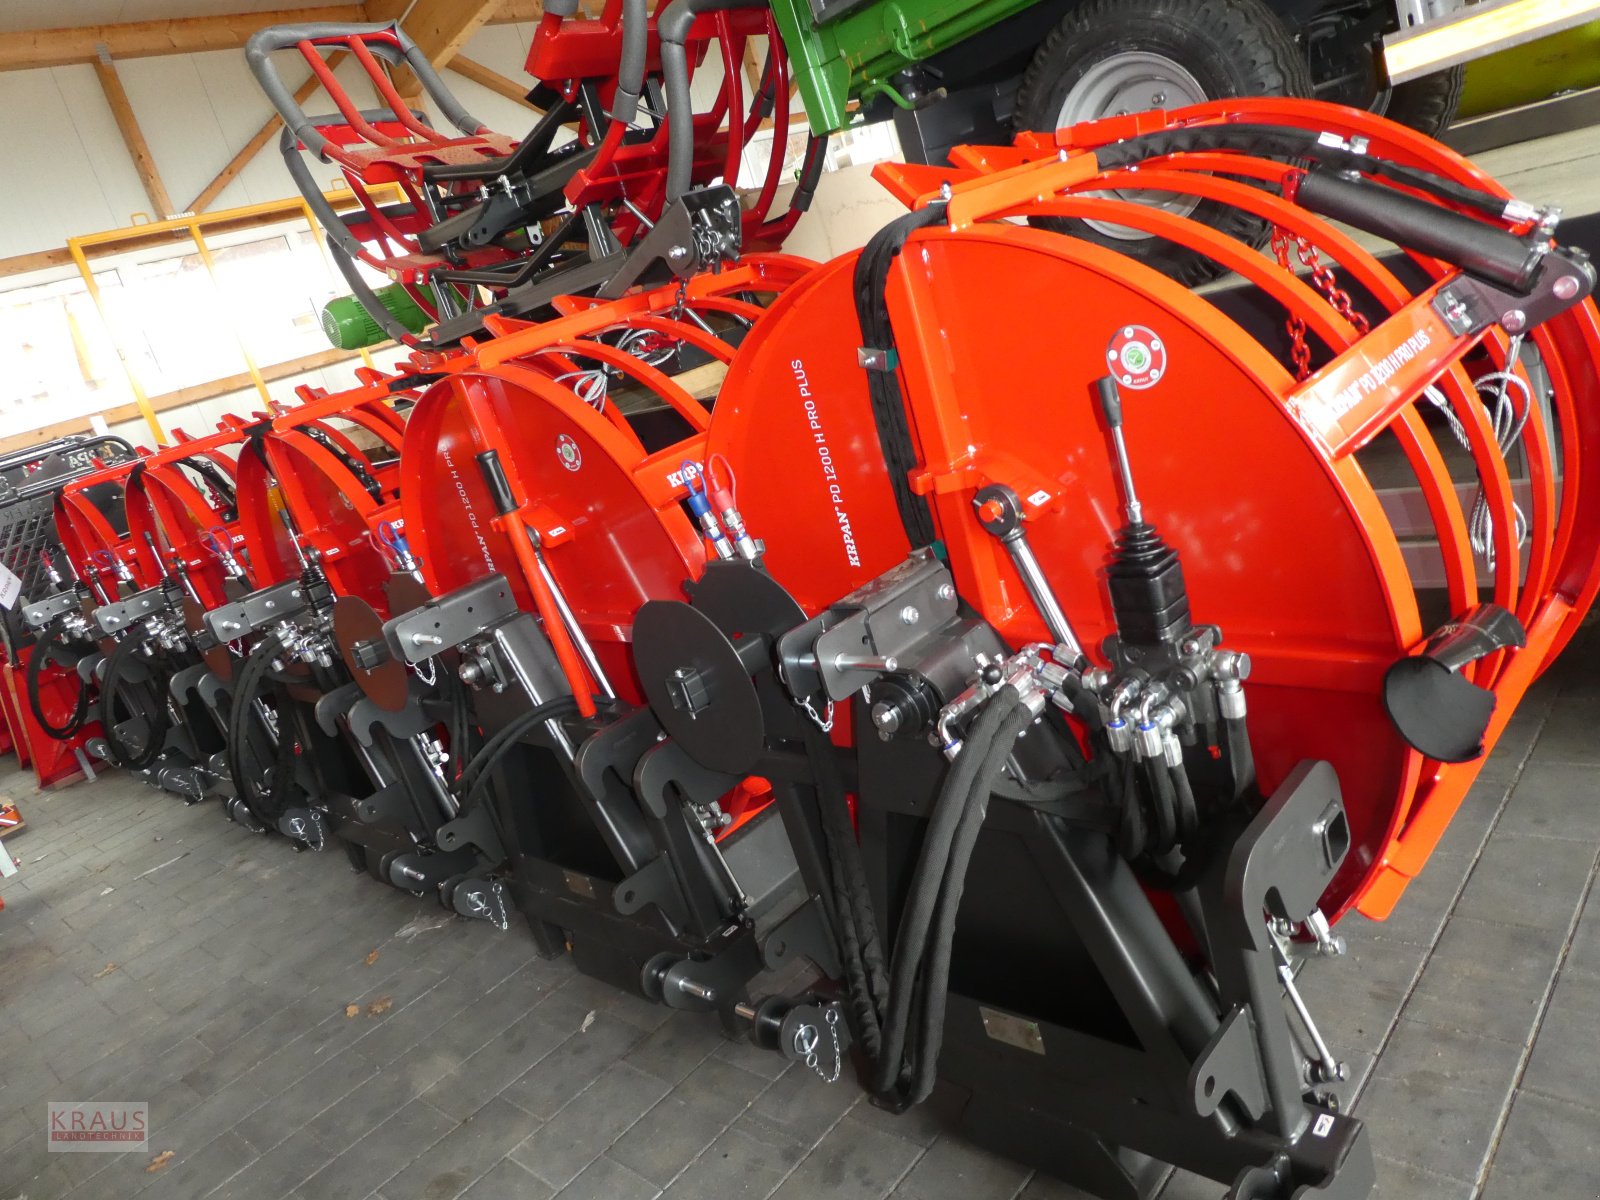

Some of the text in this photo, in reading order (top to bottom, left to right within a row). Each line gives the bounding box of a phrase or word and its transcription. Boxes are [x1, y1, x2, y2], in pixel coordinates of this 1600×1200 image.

[1359, 372, 1377, 395] PD
[1370, 358, 1394, 385] 1200
[1387, 355, 1400, 371] H
[1395, 343, 1414, 366] PRO
[1407, 328, 1431, 351] PLUS
[791, 359, 812, 397] PLUS
[804, 400, 821, 429] PRO
[814, 433, 826, 443] H
[451, 470, 459, 479] H
[817, 447, 837, 481] 1200
[455, 481, 472, 510] 1200
[829, 484, 843, 503] PD
[468, 512, 479, 529] PD
[477, 533, 496, 573] RPAN
